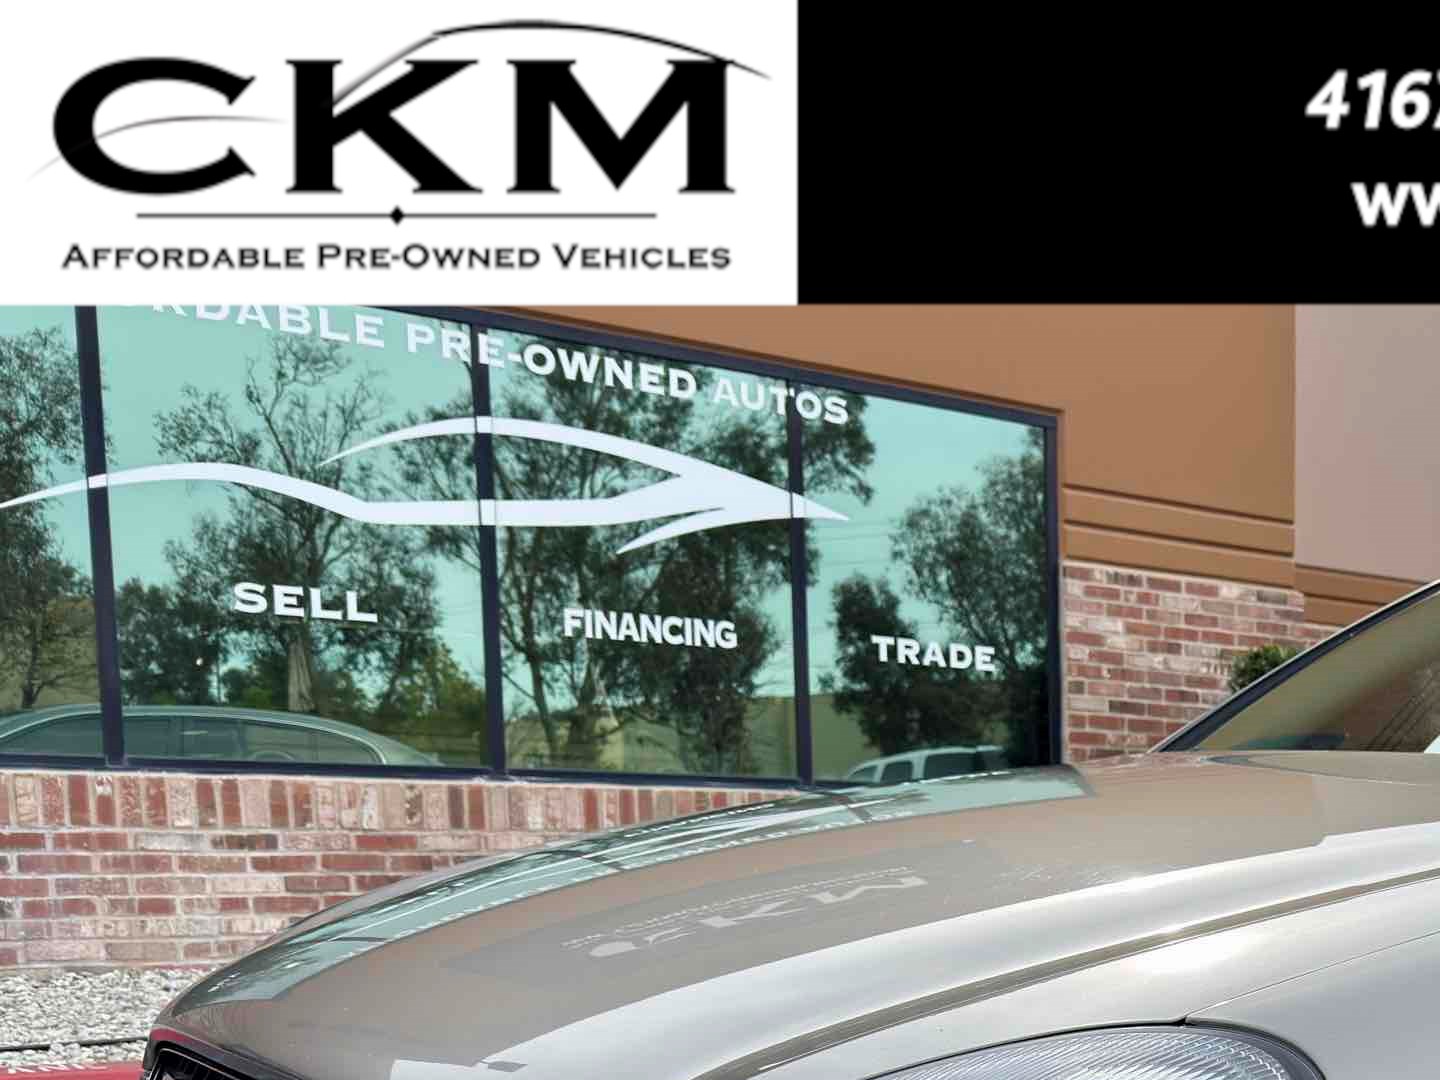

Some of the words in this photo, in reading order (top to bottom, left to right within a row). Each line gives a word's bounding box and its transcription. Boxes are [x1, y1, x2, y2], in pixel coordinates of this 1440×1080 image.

[406, 322, 697, 399] PRE-OWNED
[712, 380, 850, 426] AUTOS
[231, 581, 379, 625] SELL
[563, 605, 738, 649] FINANCING
[871, 633, 997, 672] TRADE
